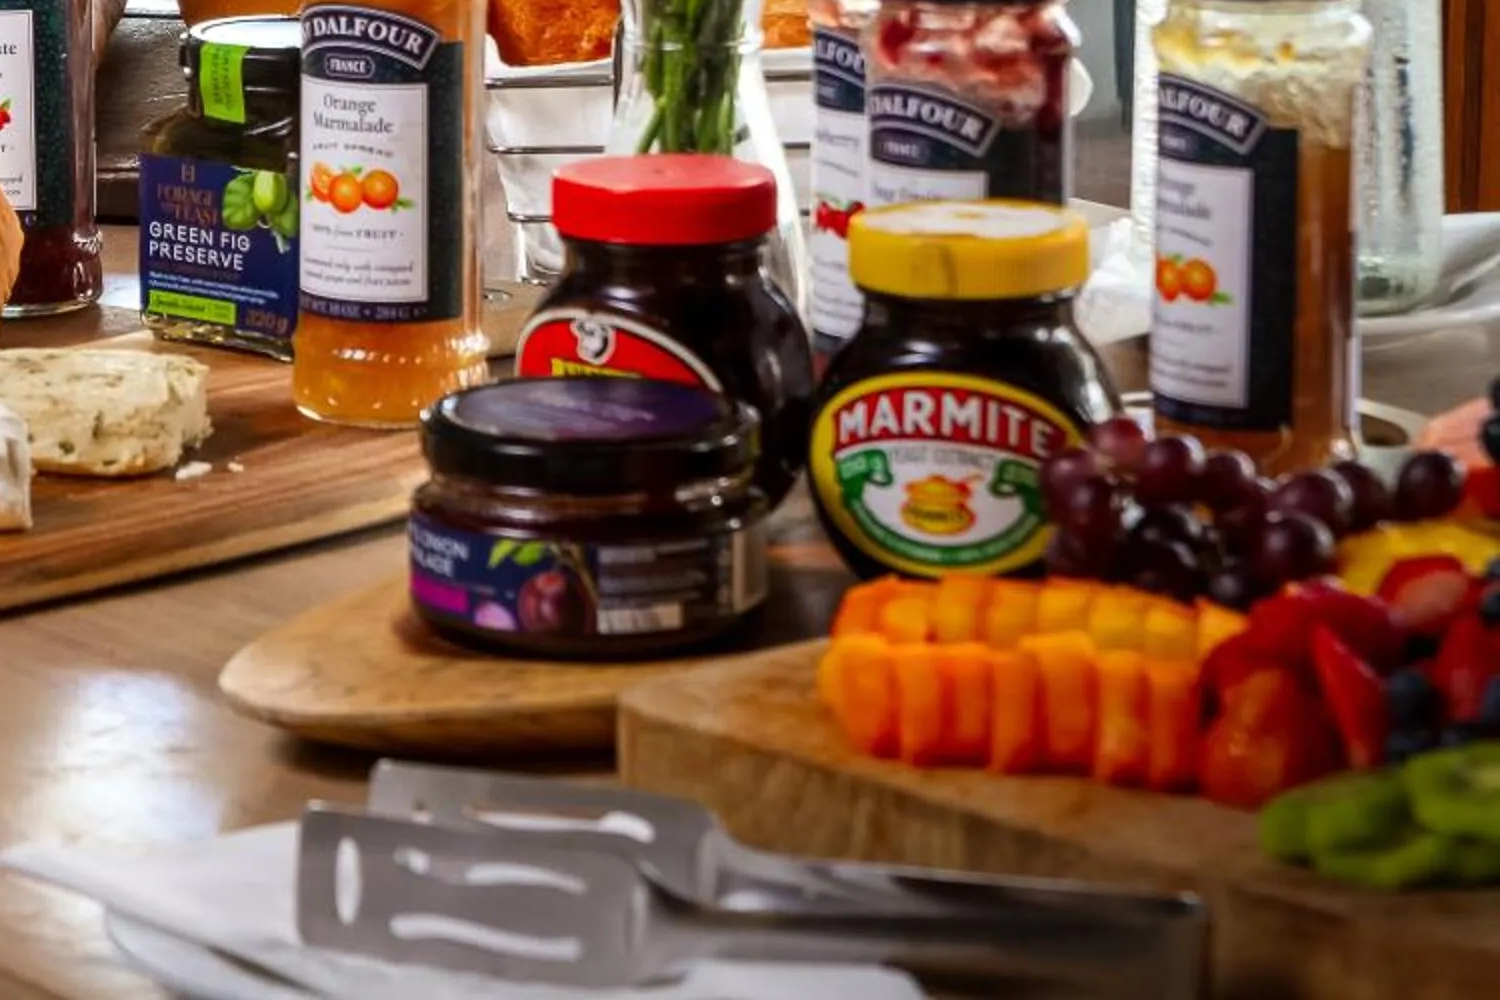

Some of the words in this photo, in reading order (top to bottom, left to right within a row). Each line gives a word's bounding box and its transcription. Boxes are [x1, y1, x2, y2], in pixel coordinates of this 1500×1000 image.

[312, 16, 425, 54] DALFOUR
[330, 58, 366, 74] FRANCE
[323, 93, 377, 117] Orange
[313, 111, 395, 134] Marmalade
[149, 221, 213, 248] GREEN
[220, 231, 251, 252] FIG
[149, 241, 245, 271] PRESERVE
[839, 389, 1053, 457] MARMITE
